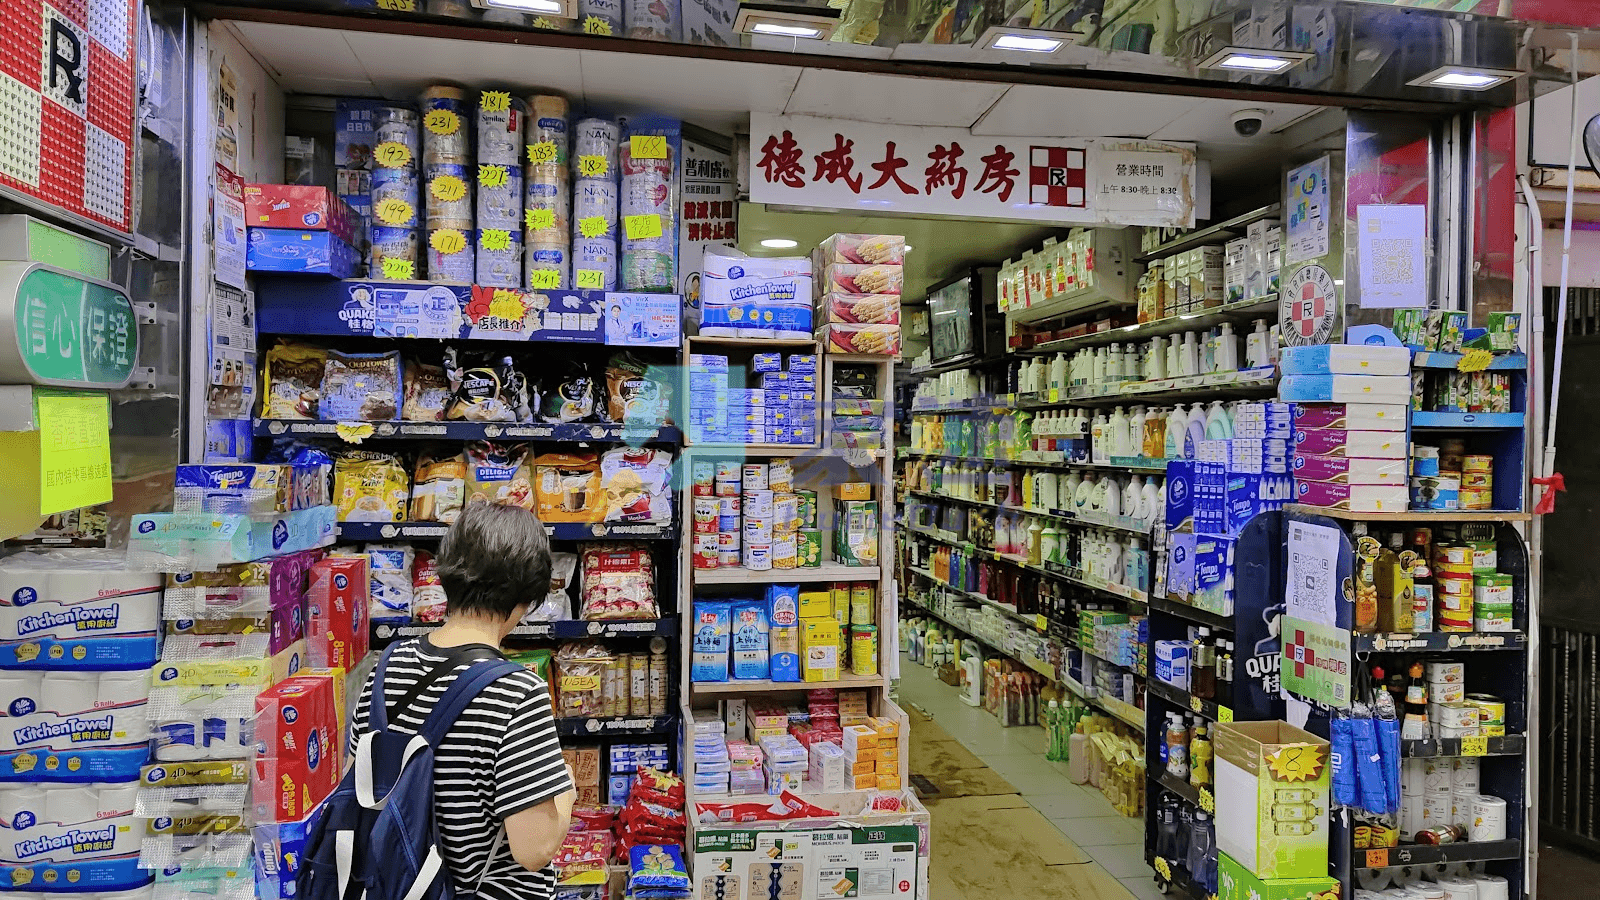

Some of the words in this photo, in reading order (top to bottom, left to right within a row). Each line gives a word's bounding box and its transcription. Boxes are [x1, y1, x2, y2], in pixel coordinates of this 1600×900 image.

[484, 95, 503, 109] 181
[430, 116, 451, 129] 231
[481, 114, 506, 123] Similac
[585, 130, 611, 140] NAN
[533, 146, 554, 161] 183
[636, 136, 662, 157] 168
[382, 146, 408, 163] 192
[1116, 164, 1164, 178] 營業時間
[439, 183, 458, 197] 211
[584, 187, 610, 196] NAN
[1101, 184, 1119, 194] 上午
[383, 202, 406, 221] 199
[440, 235, 459, 250] 171
[583, 245, 609, 254] NAN
[533, 273, 555, 285] 241
[578, 272, 602, 287] 231
[431, 296, 447, 312] 正
[338, 309, 376, 321] QUAKE
[211, 468, 244, 485] Tempo
[479, 468, 514, 476] DELIGHT
[252, 567, 266, 581] 12
[1200, 563, 1219, 576] Tempo
[18, 603, 119, 635] KitchenTowel
[1246, 655, 1281, 678] QUA
[13, 715, 114, 745] KitchenTowel
[1285, 746, 1304, 772] 8
[231, 763, 245, 776] 12
[15, 825, 116, 858] KitchenTowel
